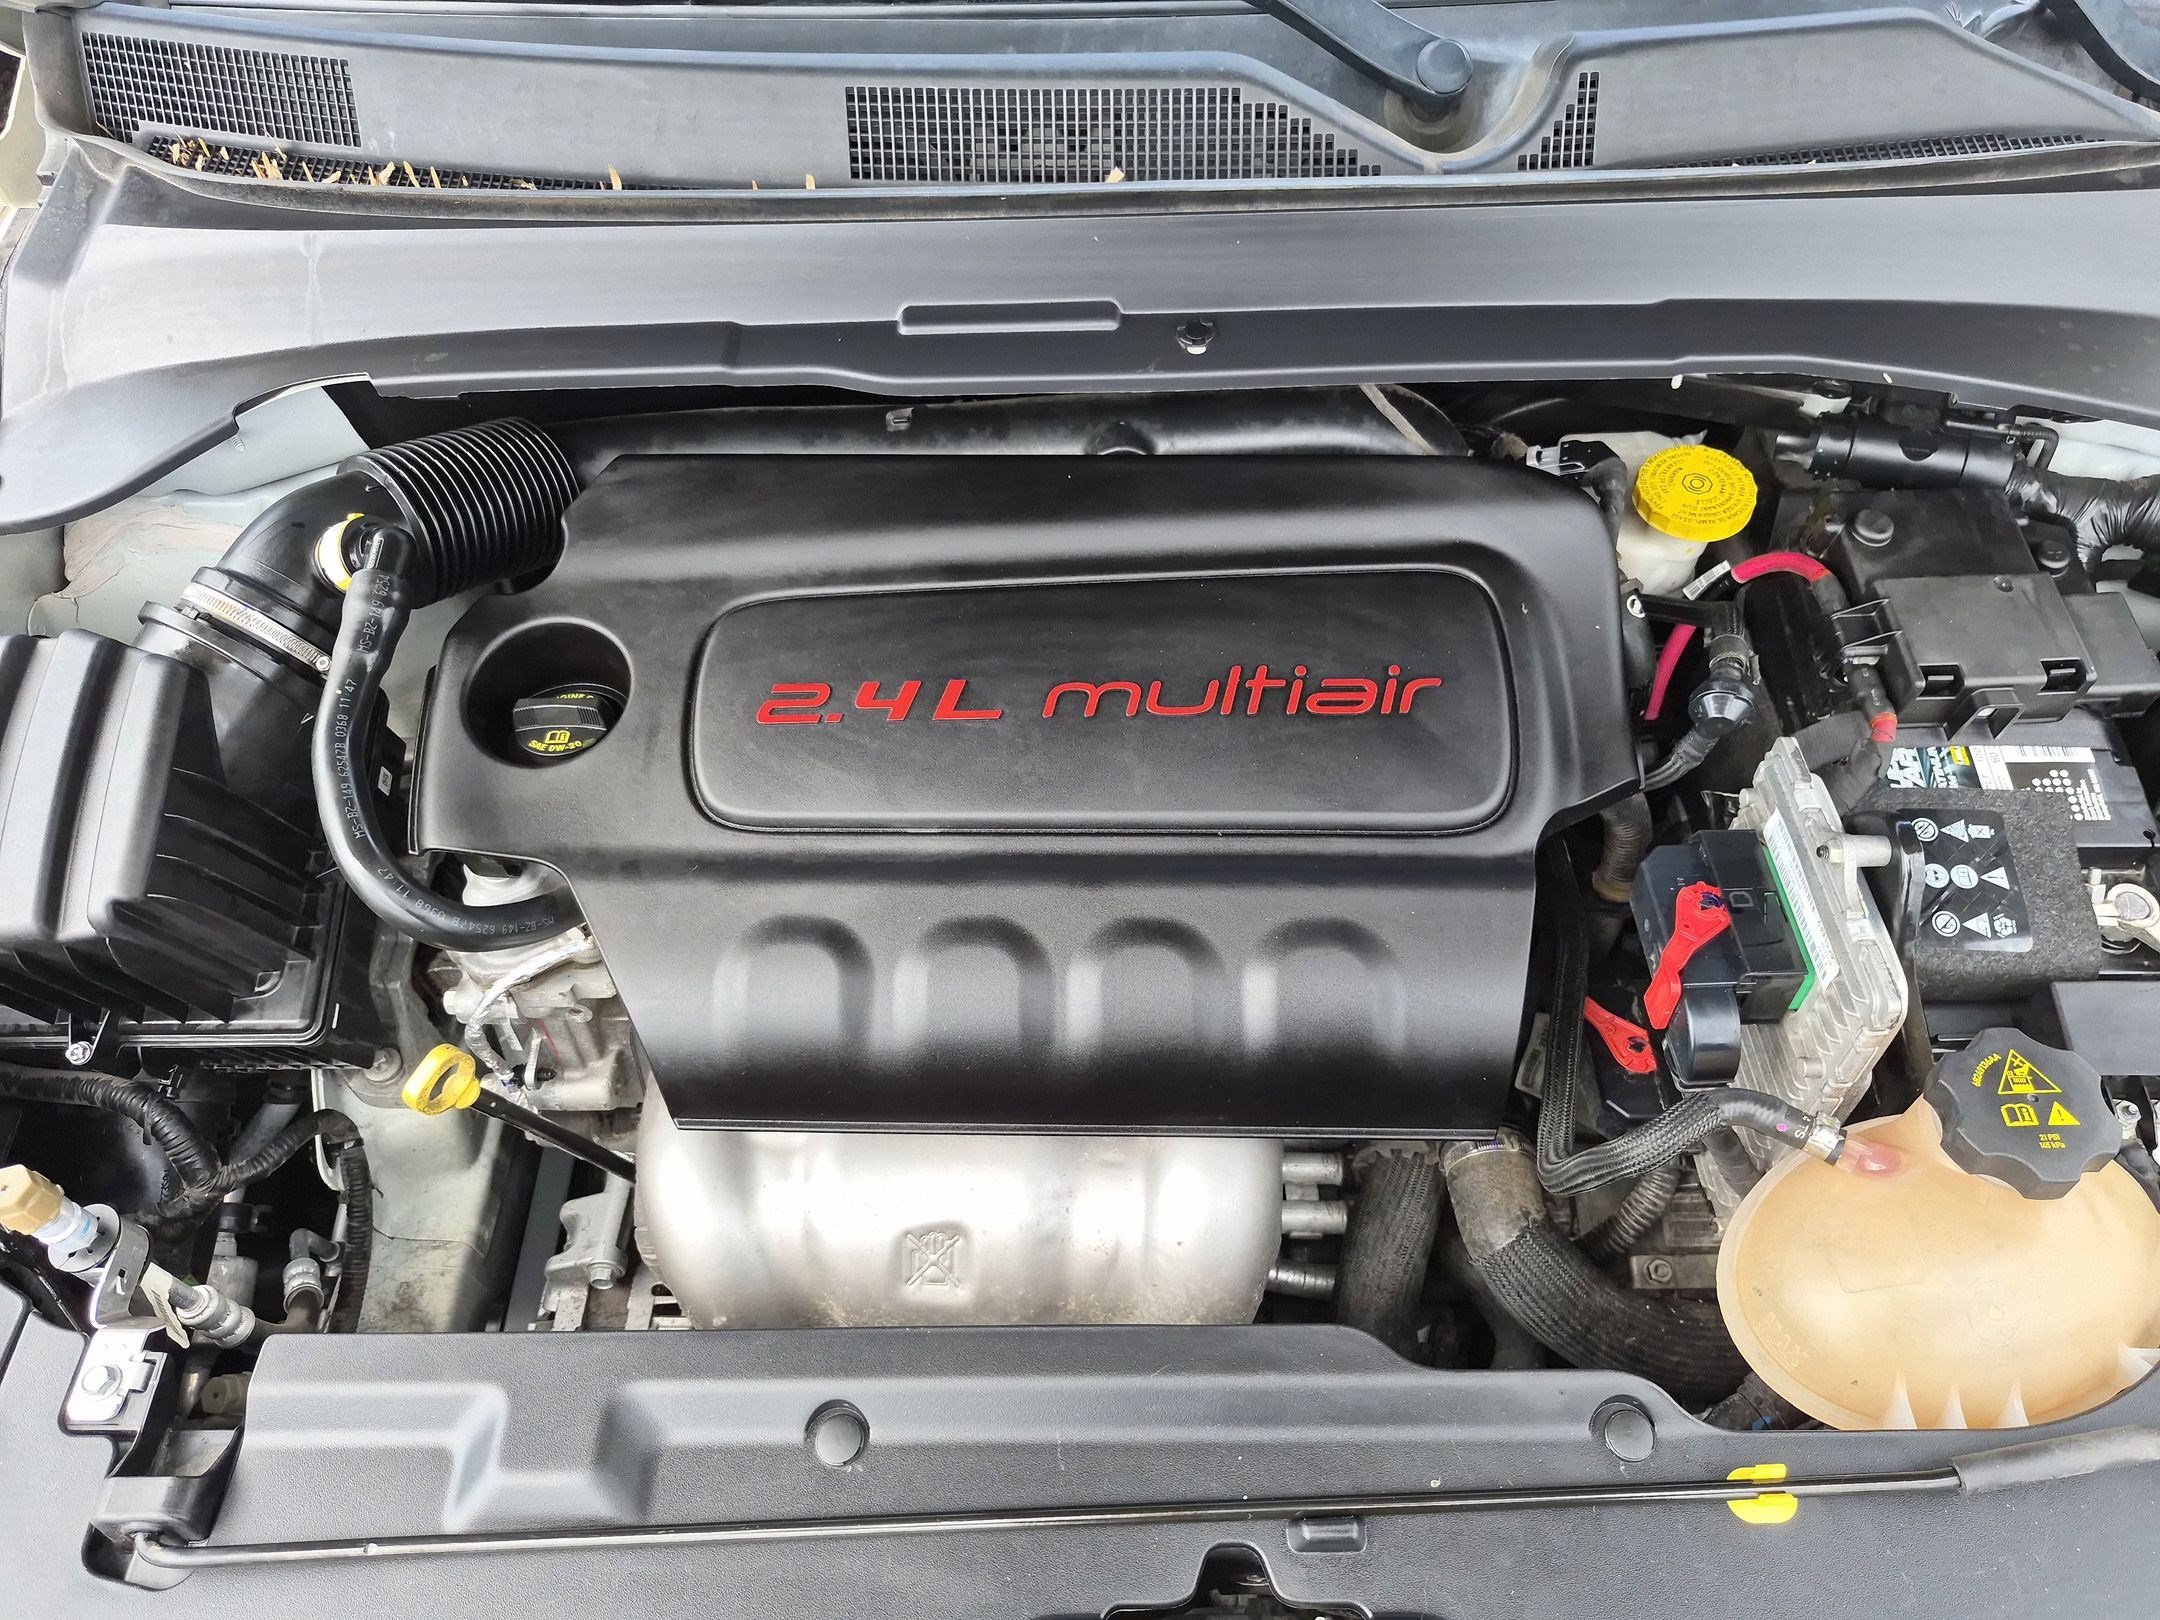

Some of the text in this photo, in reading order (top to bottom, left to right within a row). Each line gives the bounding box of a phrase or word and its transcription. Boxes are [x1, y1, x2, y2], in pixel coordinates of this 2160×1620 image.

[338, 679, 358, 709] 11:47
[1042, 664, 1443, 719] multiair
[337, 712, 349, 738] 0368
[528, 740, 548, 752] SAE
[374, 867, 411, 899] 11:47
[414, 898, 447, 922] 0368
[2038, 1133, 2061, 1141] 21 PSI
